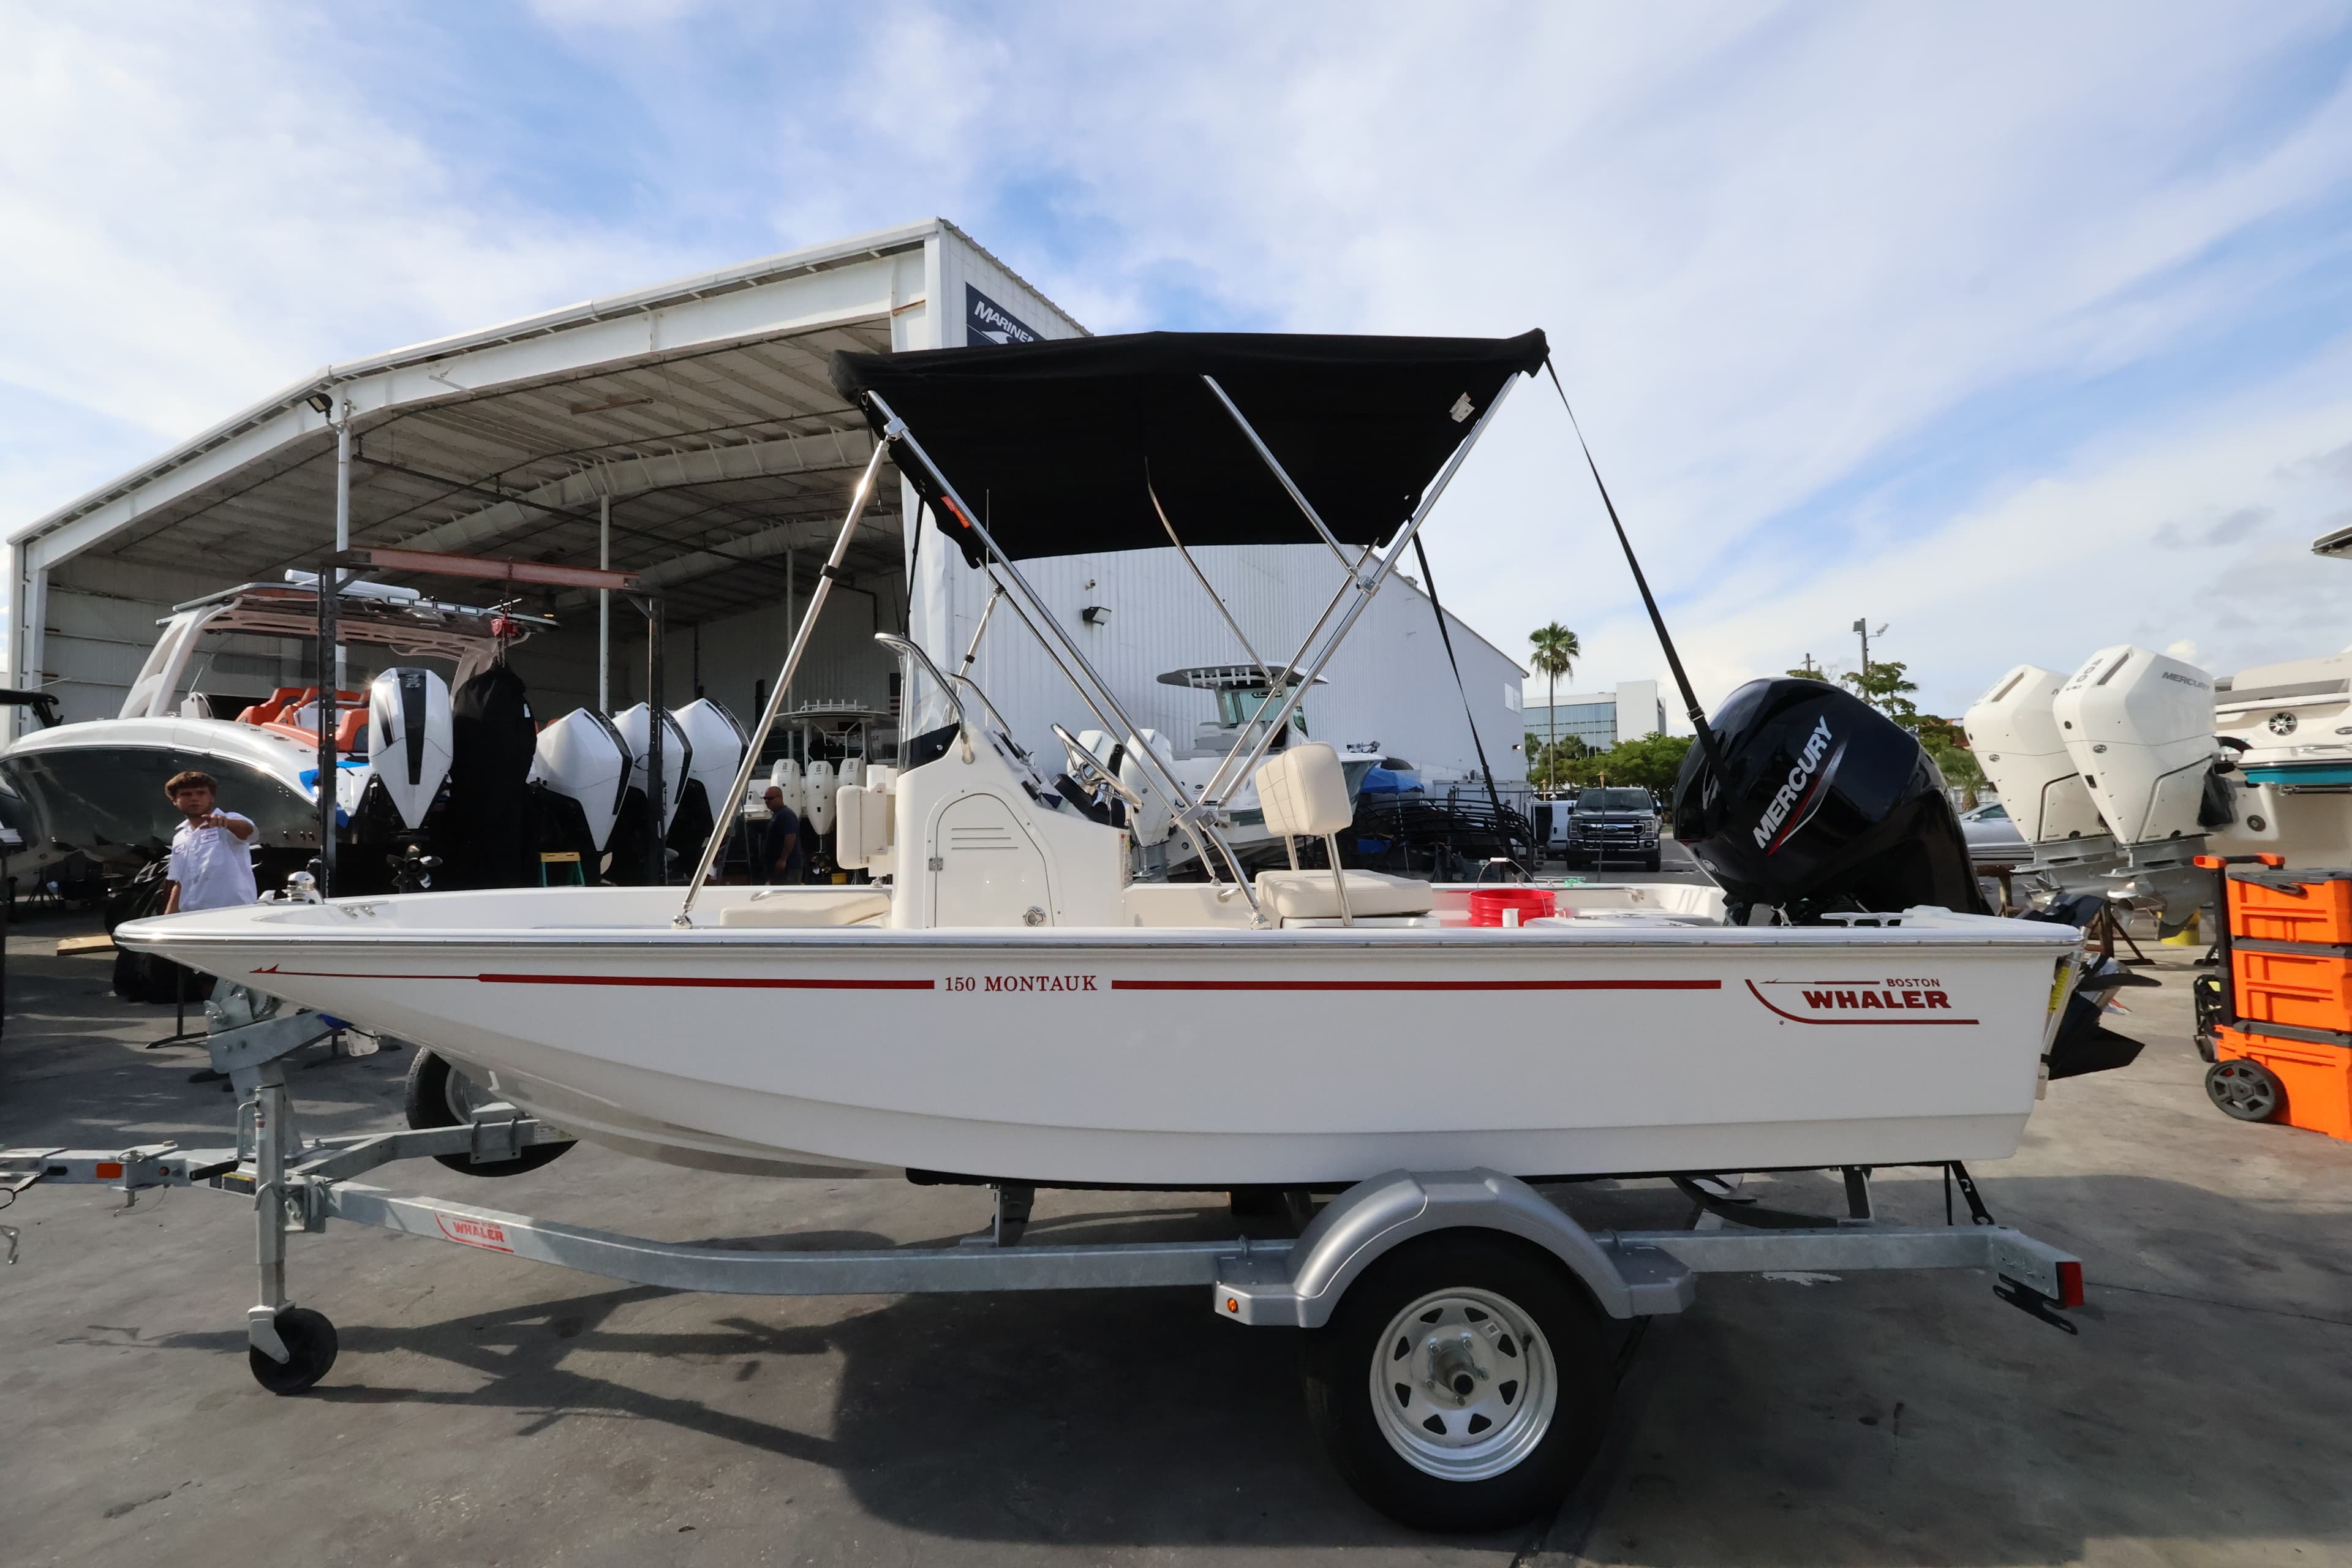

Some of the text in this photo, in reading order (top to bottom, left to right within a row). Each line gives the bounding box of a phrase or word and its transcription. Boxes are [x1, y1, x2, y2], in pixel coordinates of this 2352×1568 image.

[1753, 715, 1832, 849] MERCURY
[945, 976, 1098, 991] 150 MONTAUK
[1802, 990, 1952, 1009] WHALER
[453, 1222, 505, 1242] WHALER
